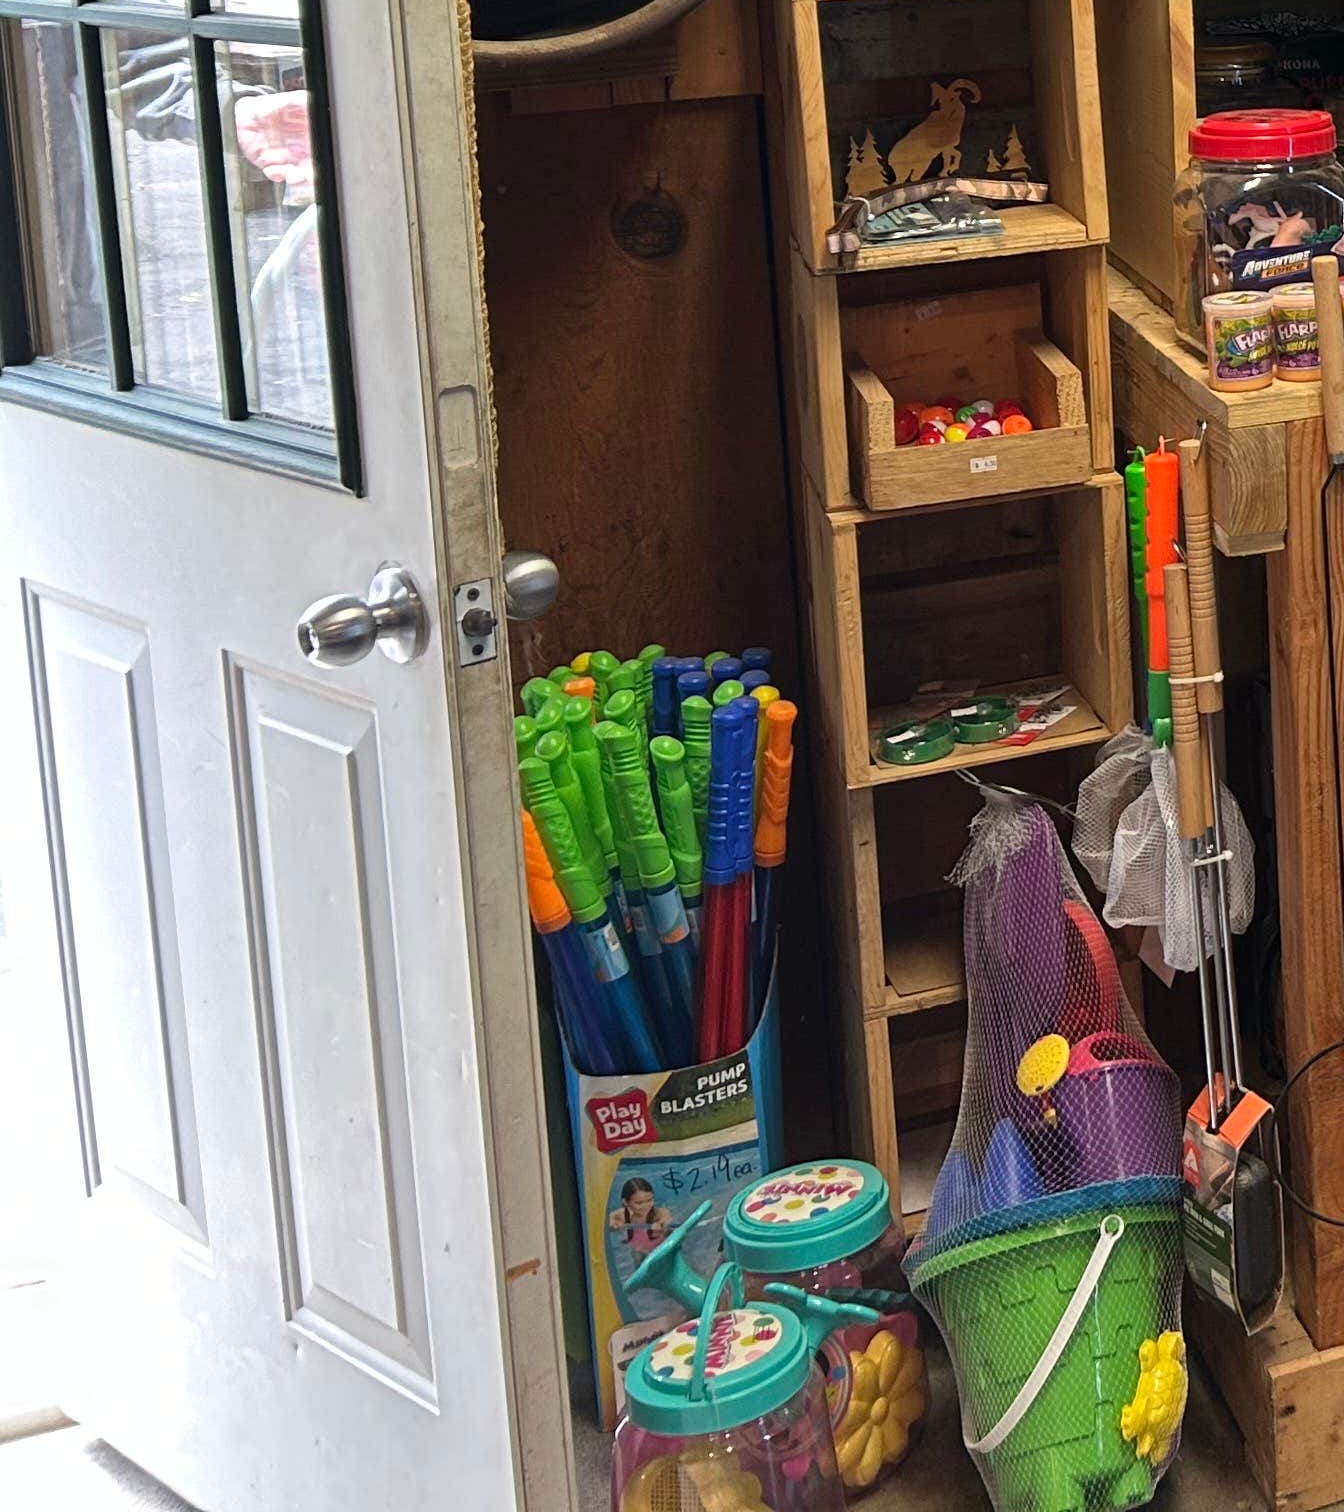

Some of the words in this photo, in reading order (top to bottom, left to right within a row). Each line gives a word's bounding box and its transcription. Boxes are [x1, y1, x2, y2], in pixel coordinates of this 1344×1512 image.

[697, 1063, 746, 1091] PUMP
[660, 1080, 749, 1117] BLASTERS
[595, 1100, 642, 1124] Play
[603, 1116, 647, 1141] Day
